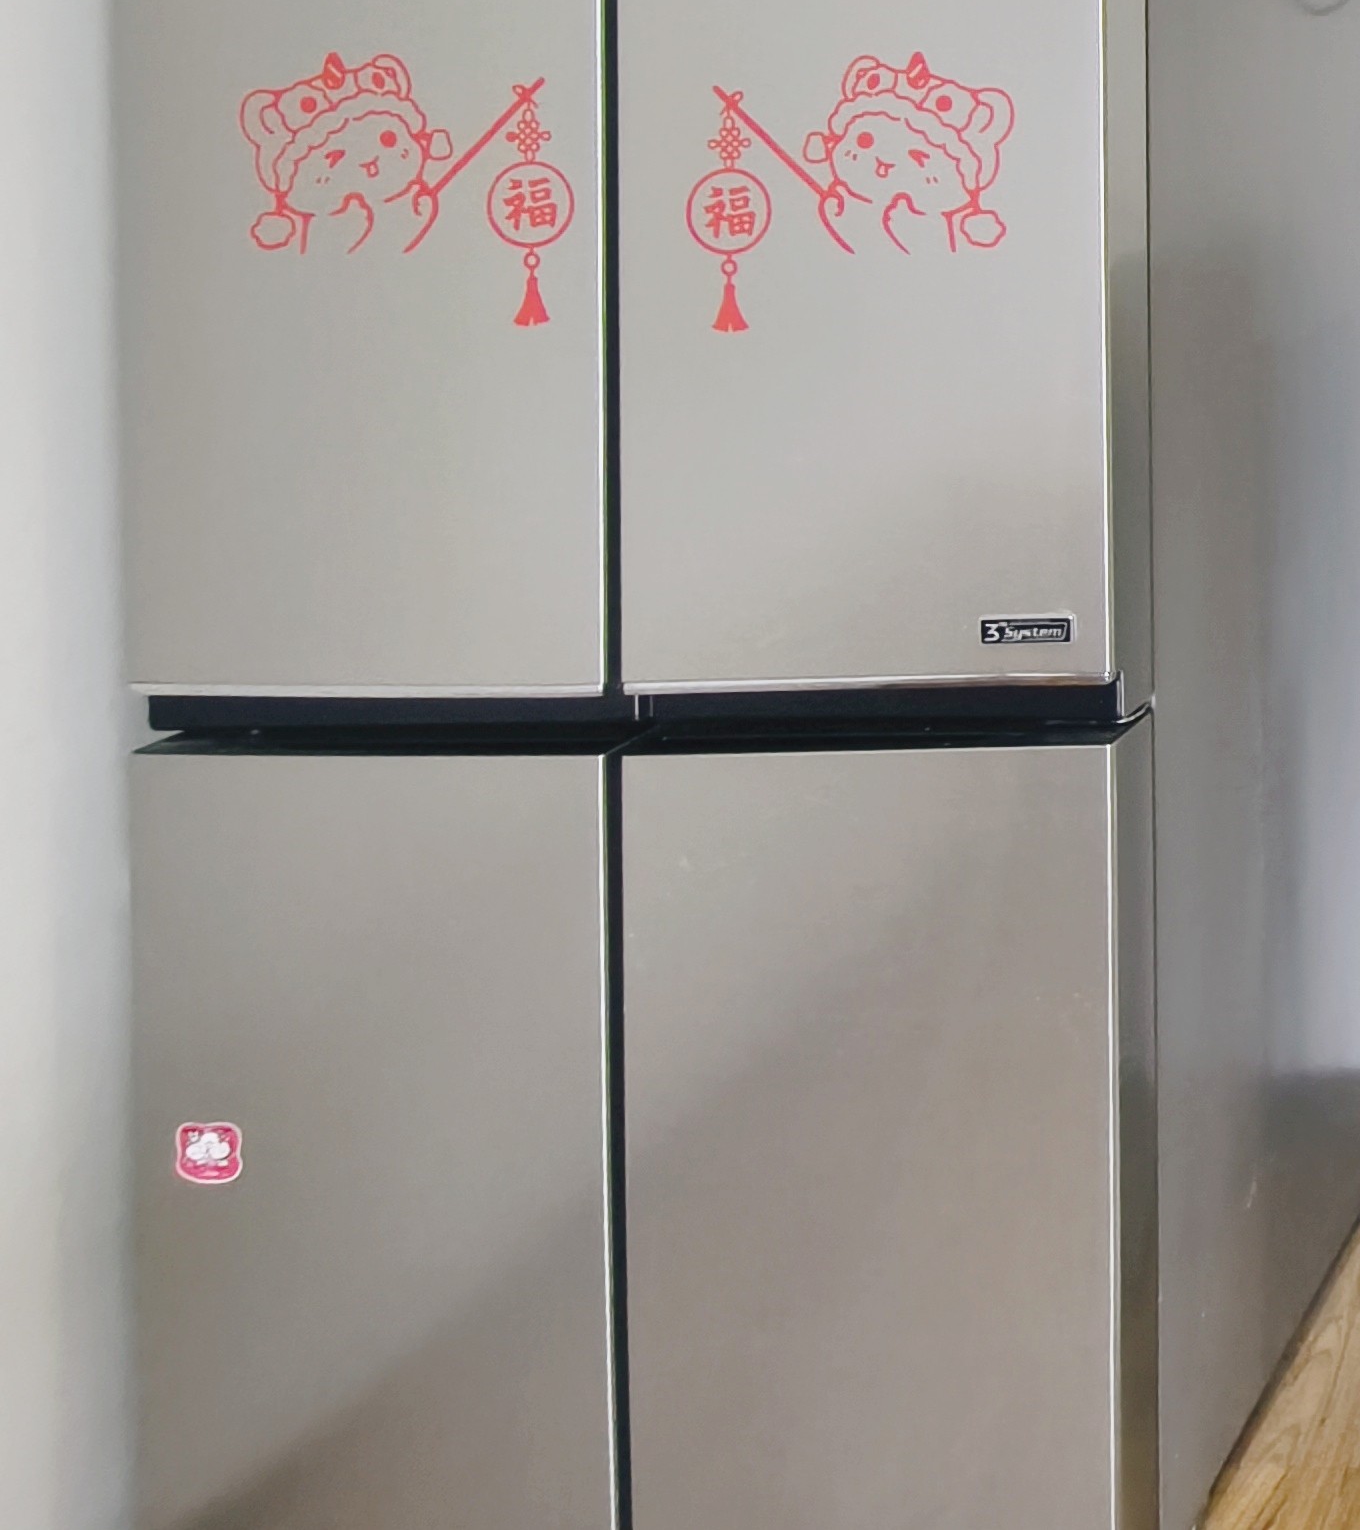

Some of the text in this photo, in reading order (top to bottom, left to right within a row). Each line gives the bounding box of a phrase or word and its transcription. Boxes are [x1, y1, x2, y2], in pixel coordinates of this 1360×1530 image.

[503, 177, 558, 231] 福
[703, 185, 757, 239] 福
[983, 623, 1063, 642] 3 System
